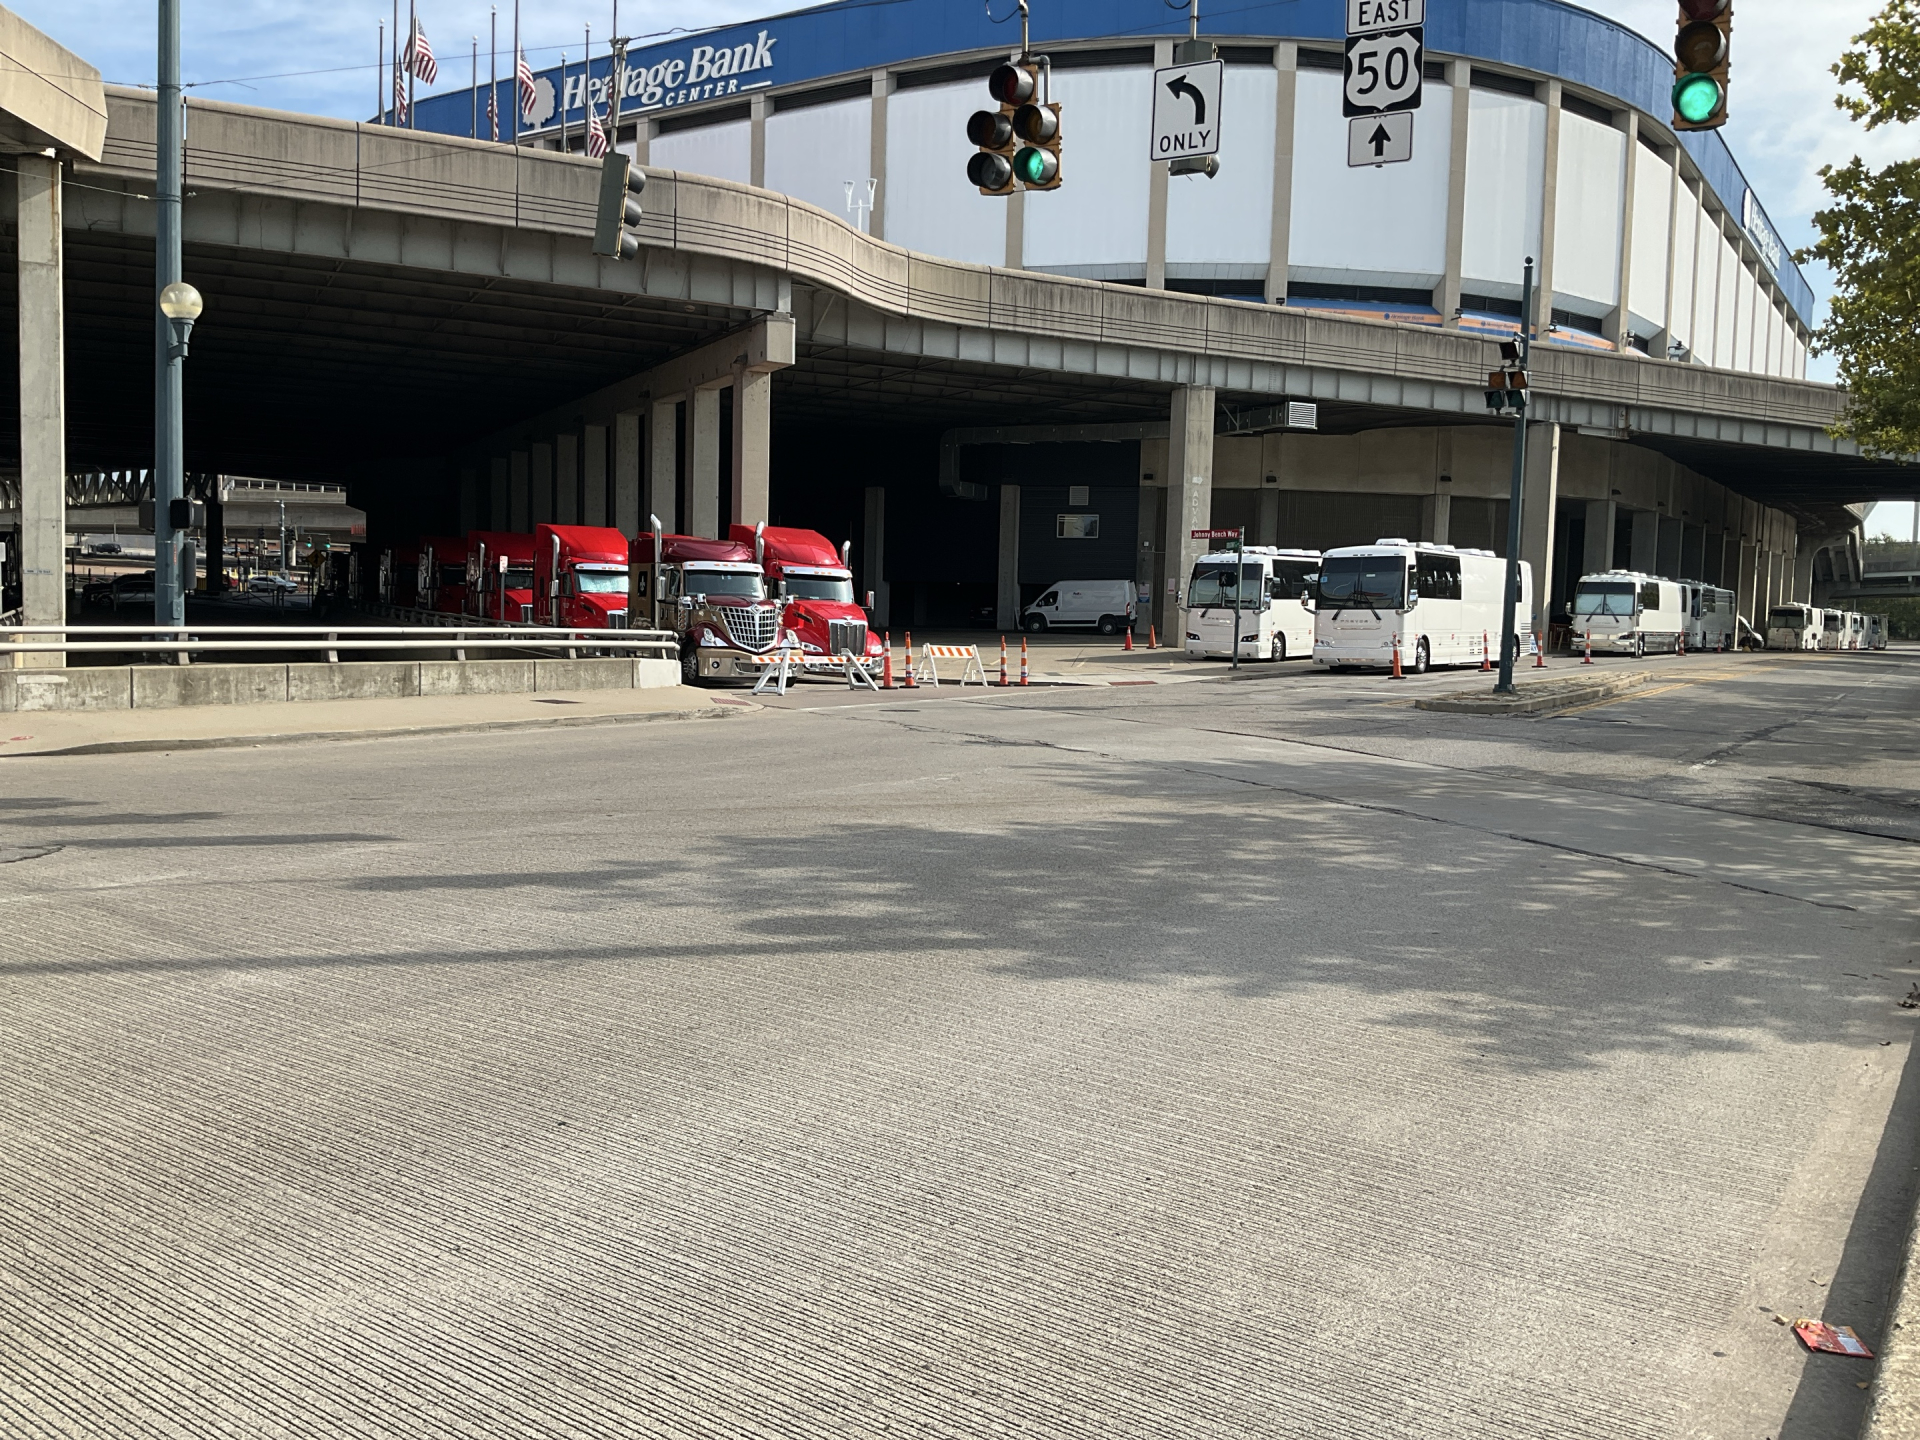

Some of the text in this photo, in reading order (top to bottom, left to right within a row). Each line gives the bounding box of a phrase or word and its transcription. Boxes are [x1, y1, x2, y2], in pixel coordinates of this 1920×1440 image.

[1358, 0, 1412, 27] EAST
[559, 29, 778, 112] Hertage Bank
[1356, 46, 1409, 96] 50
[664, 78, 738, 107] CENTER
[1159, 129, 1211, 153] ONLY
[1211, 530, 1227, 538] Bench
[1227, 530, 1238, 538] Way
